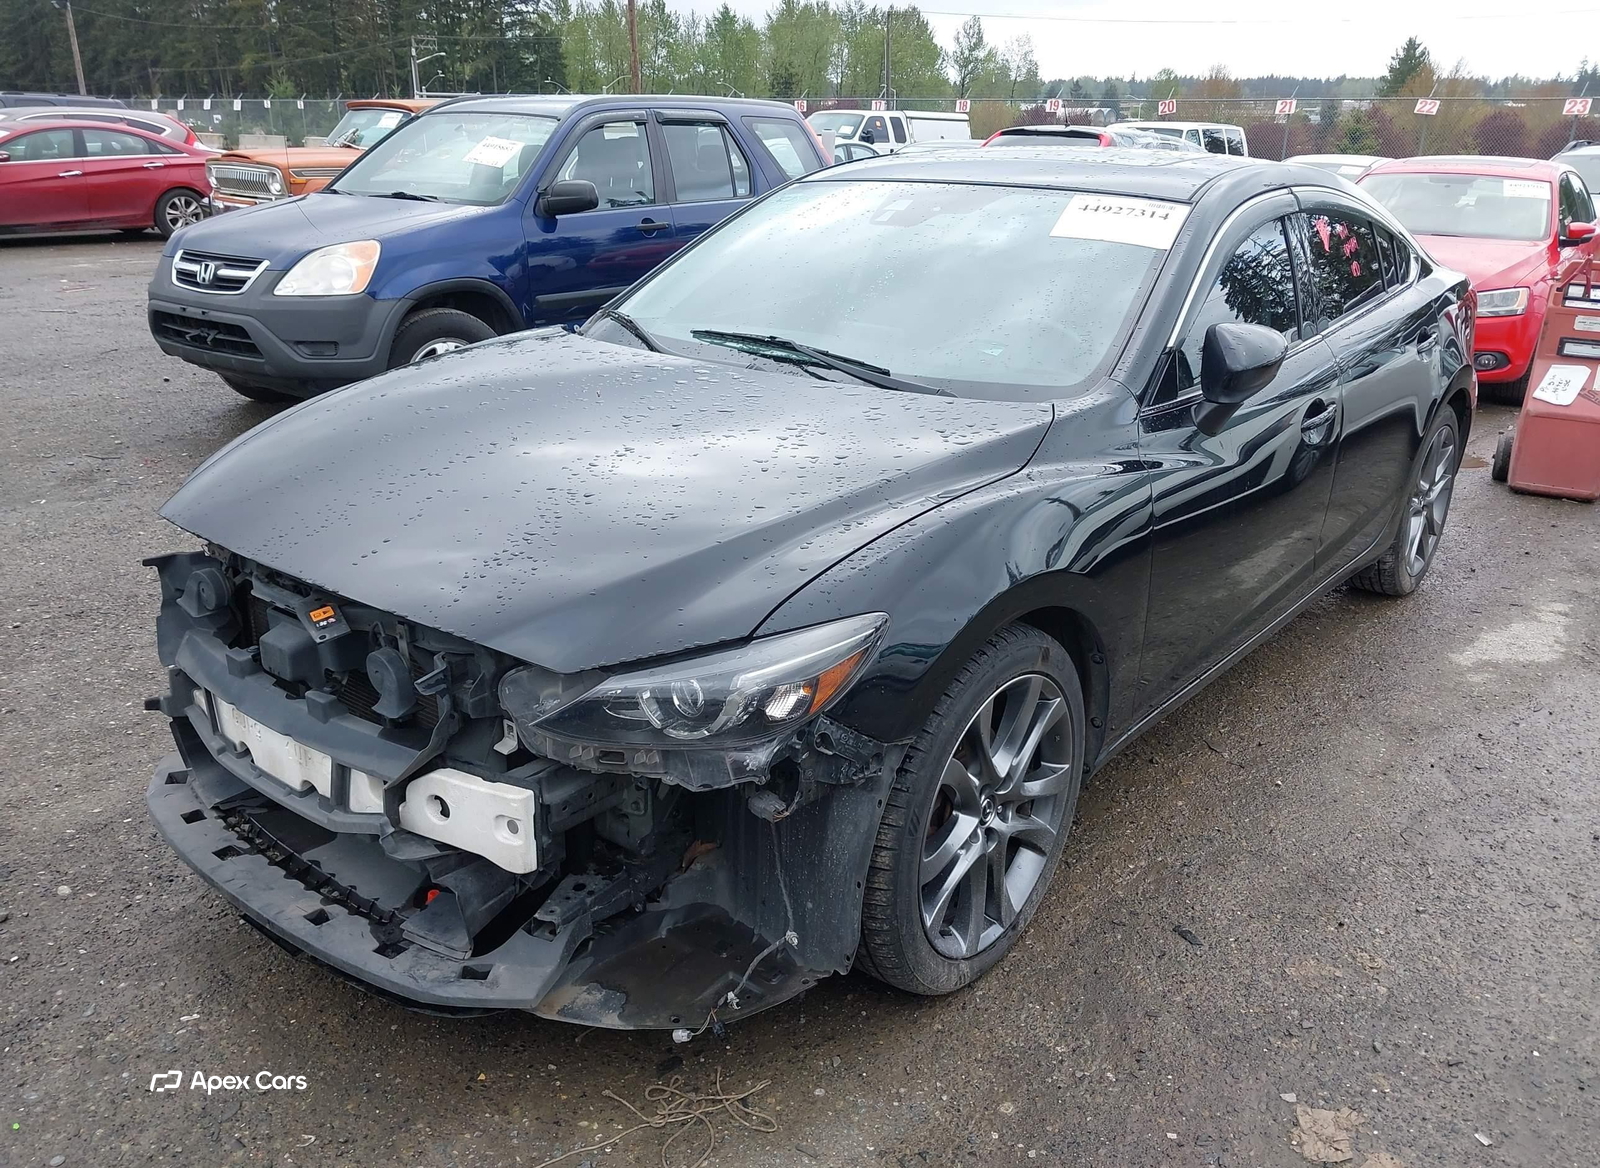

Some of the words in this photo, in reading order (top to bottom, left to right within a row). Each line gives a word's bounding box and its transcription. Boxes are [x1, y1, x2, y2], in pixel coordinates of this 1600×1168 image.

[796, 101, 805, 111] 16
[874, 101, 882, 111] 17
[958, 101, 968, 112] 18
[1048, 99, 1060, 112] 19
[1160, 100, 1175, 114] 20
[1278, 100, 1294, 113] 21
[1418, 100, 1438, 114] 22
[1564, 99, 1589, 114] 23
[1078, 204, 1170, 220] 44927314
